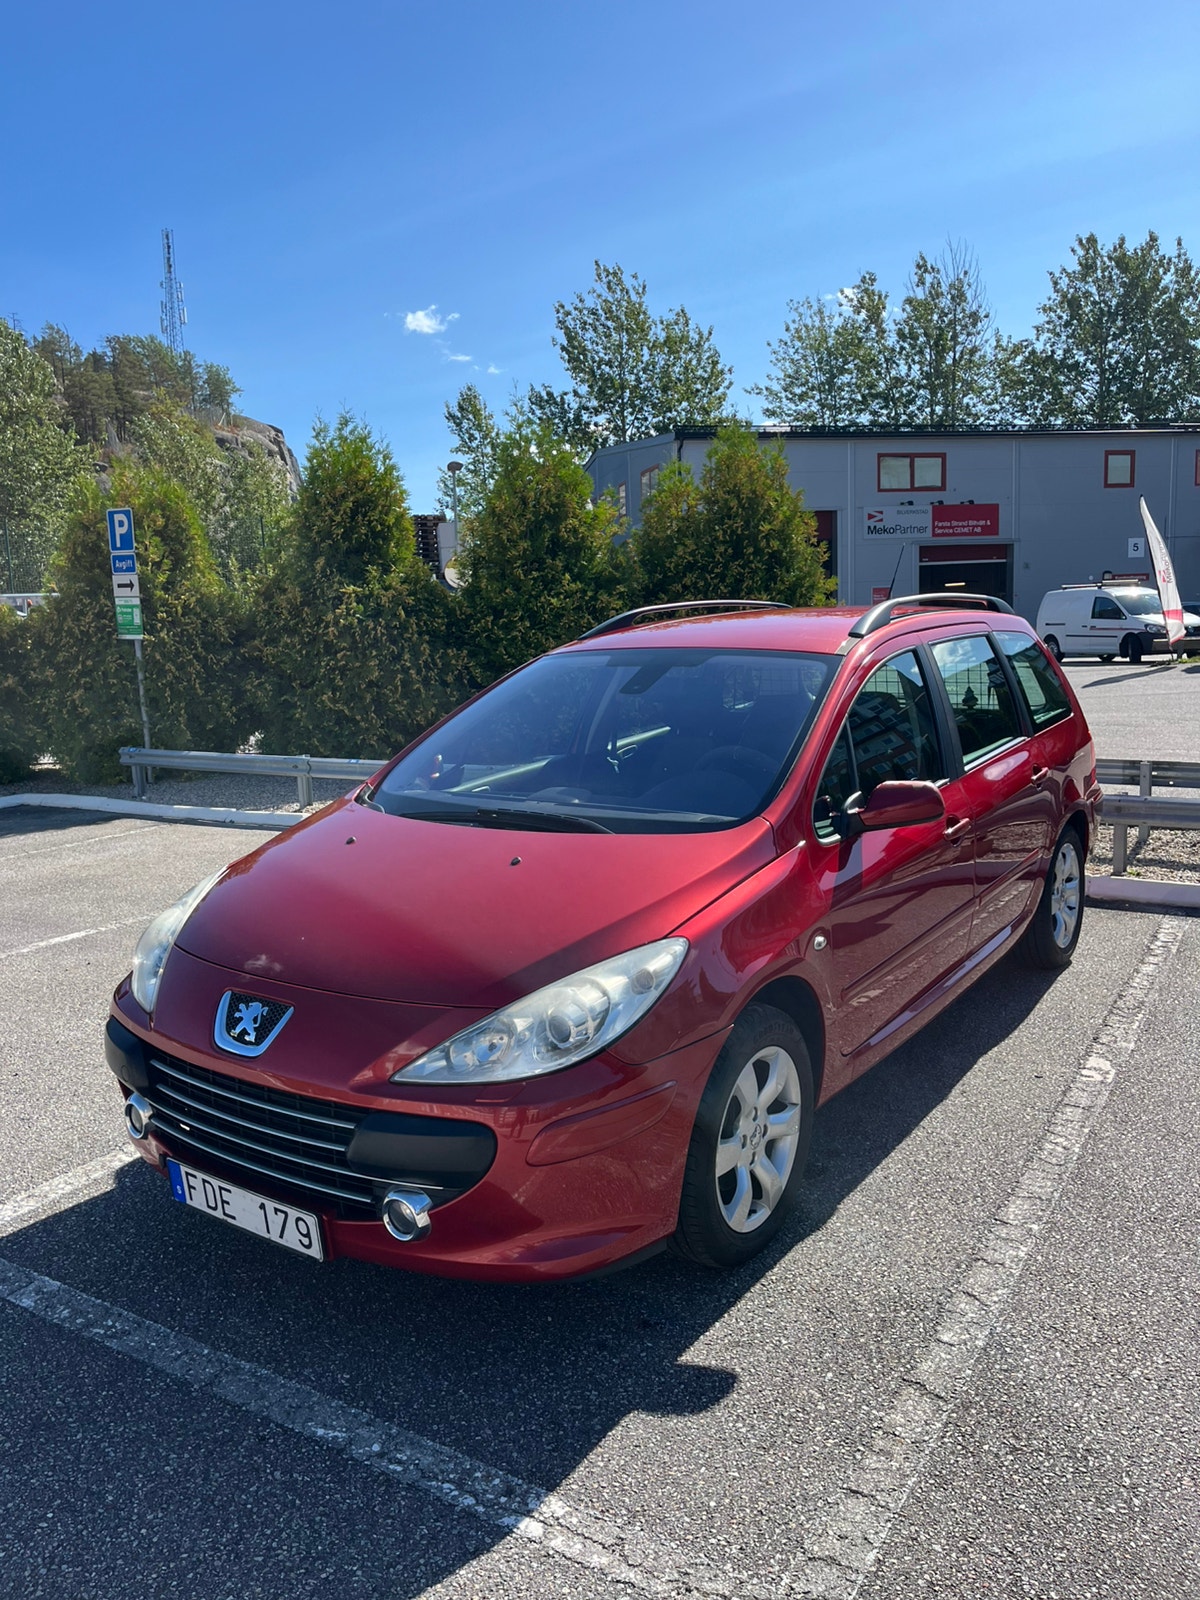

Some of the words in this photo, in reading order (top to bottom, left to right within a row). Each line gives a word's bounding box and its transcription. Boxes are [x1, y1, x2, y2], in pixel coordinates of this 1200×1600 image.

[113, 513, 129, 548] P
[867, 524, 928, 535] MekoPartner
[1132, 542, 1139, 552] 5
[115, 559, 133, 570] Avgift
[176, 1185, 182, 1194] S
[184, 1170, 236, 1221] FDE
[259, 1202, 312, 1250] 179
